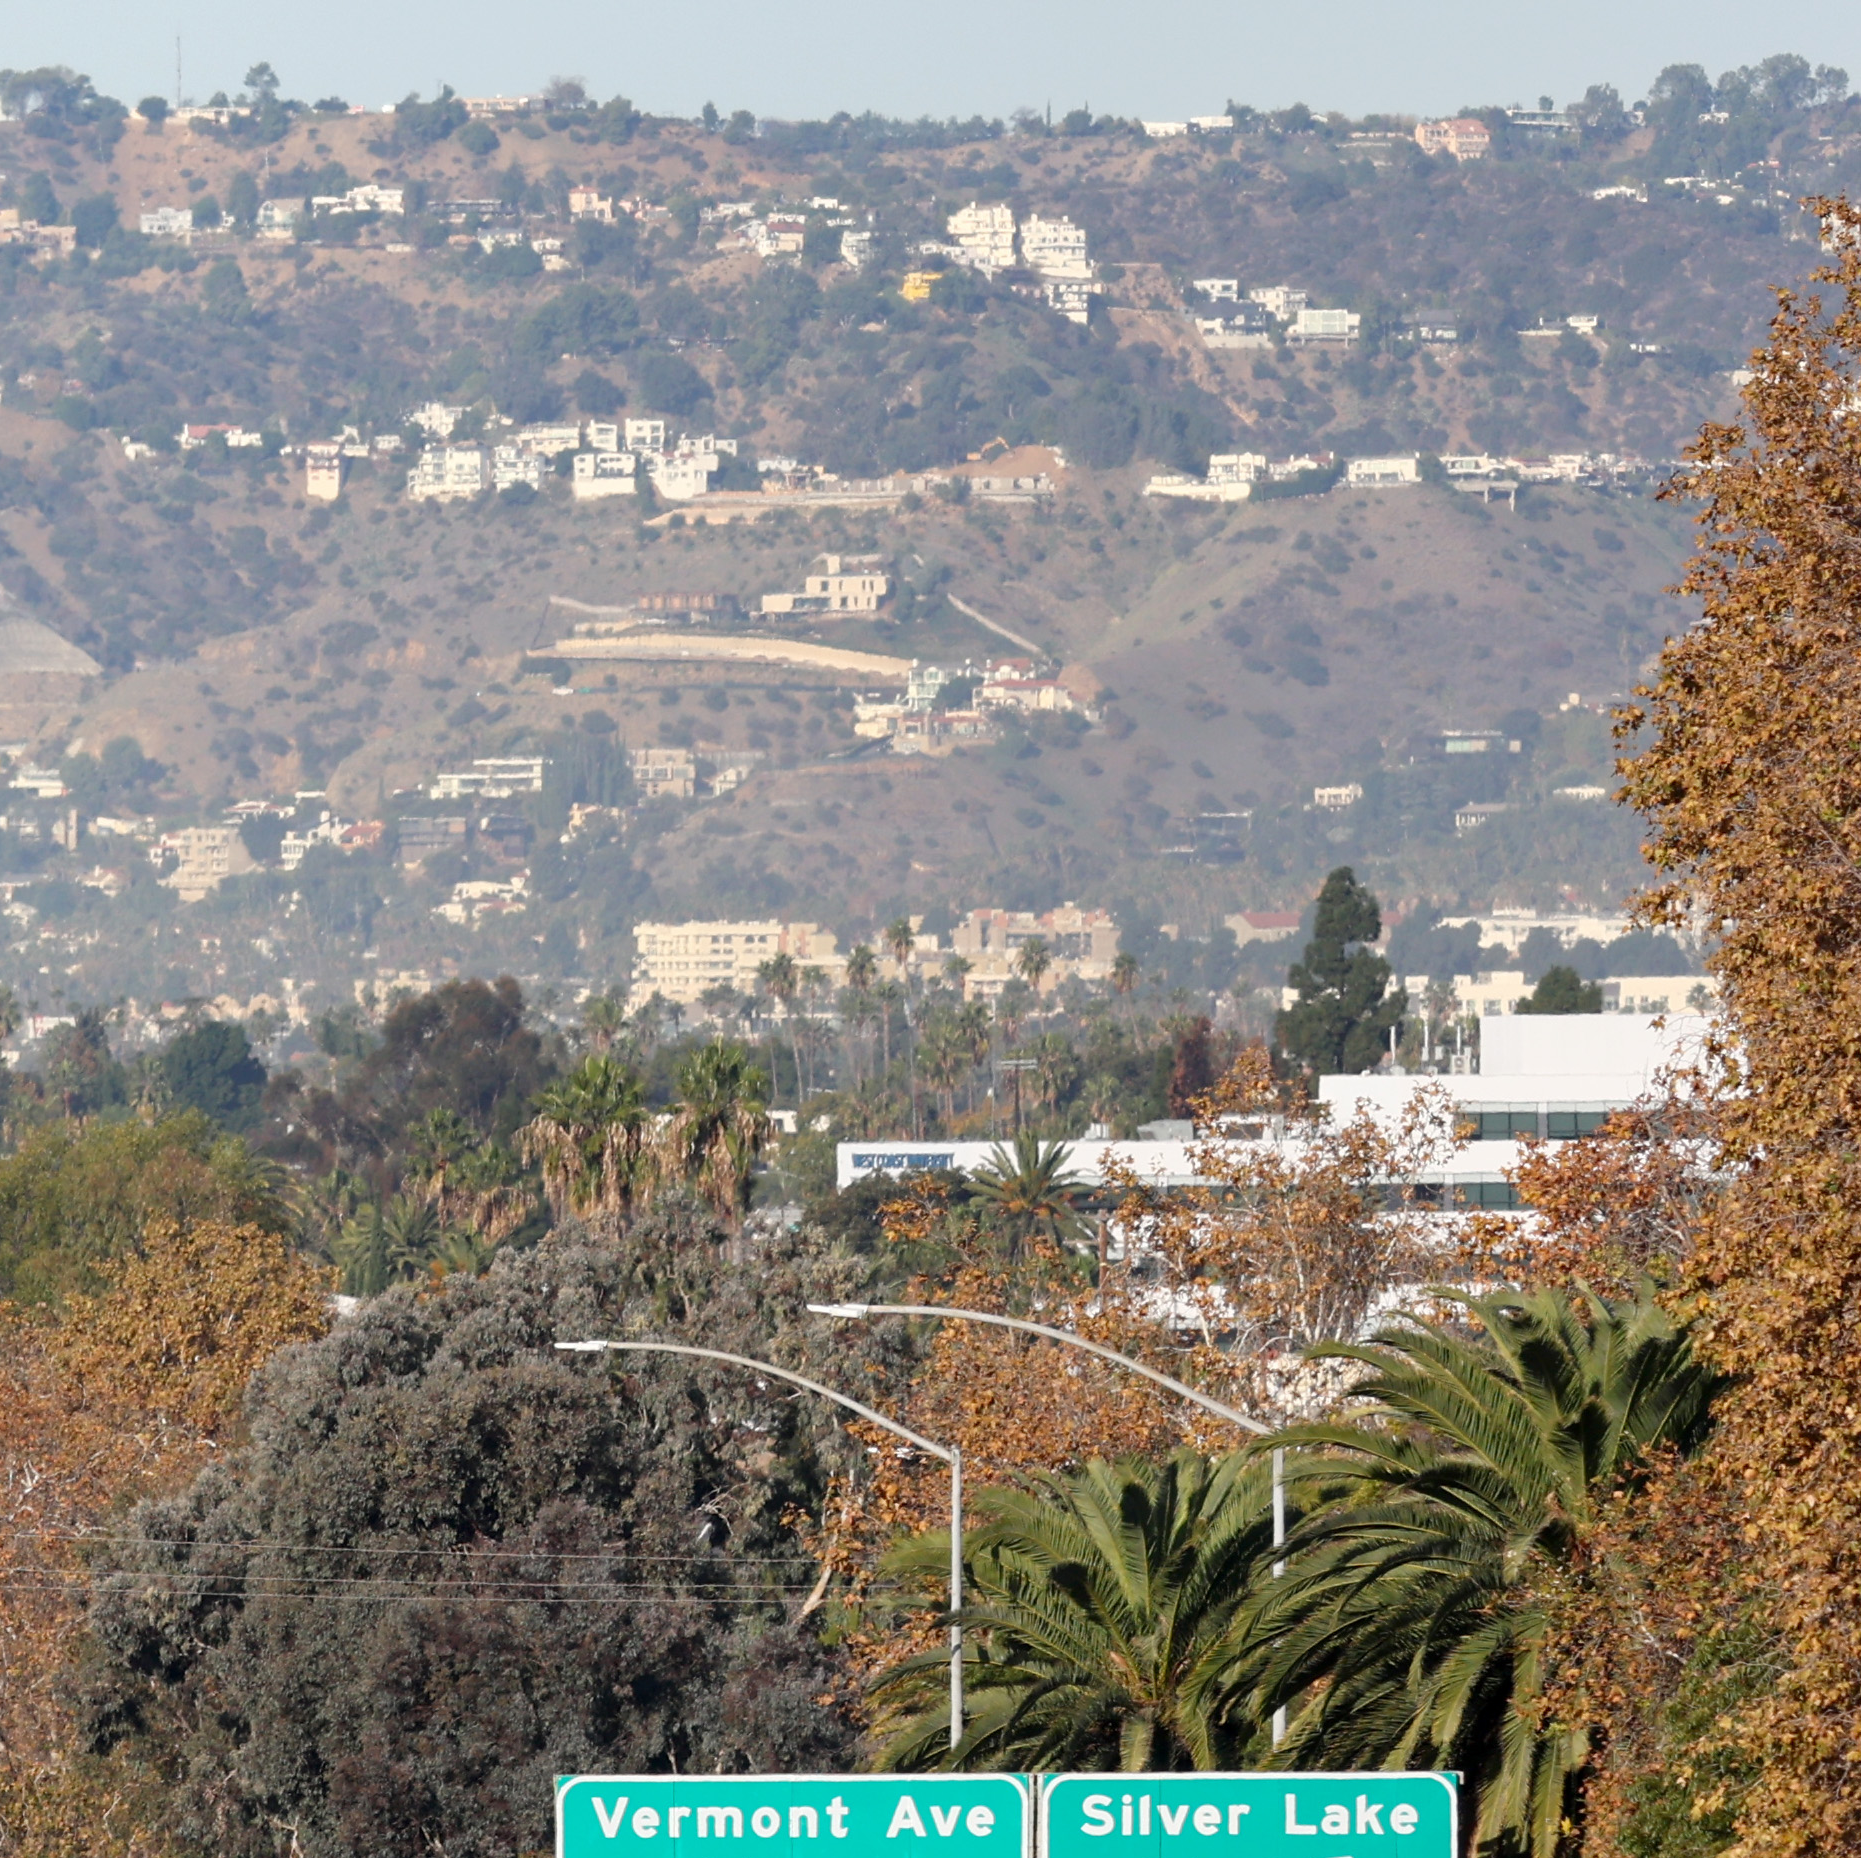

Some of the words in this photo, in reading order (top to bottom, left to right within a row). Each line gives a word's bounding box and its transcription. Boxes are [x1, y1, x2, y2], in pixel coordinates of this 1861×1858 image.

[591, 1795, 850, 1840] Vermont
[885, 1794, 999, 1839] Ave
[1080, 1793, 1252, 1838] Silver
[1284, 1793, 1420, 1836] Lake
